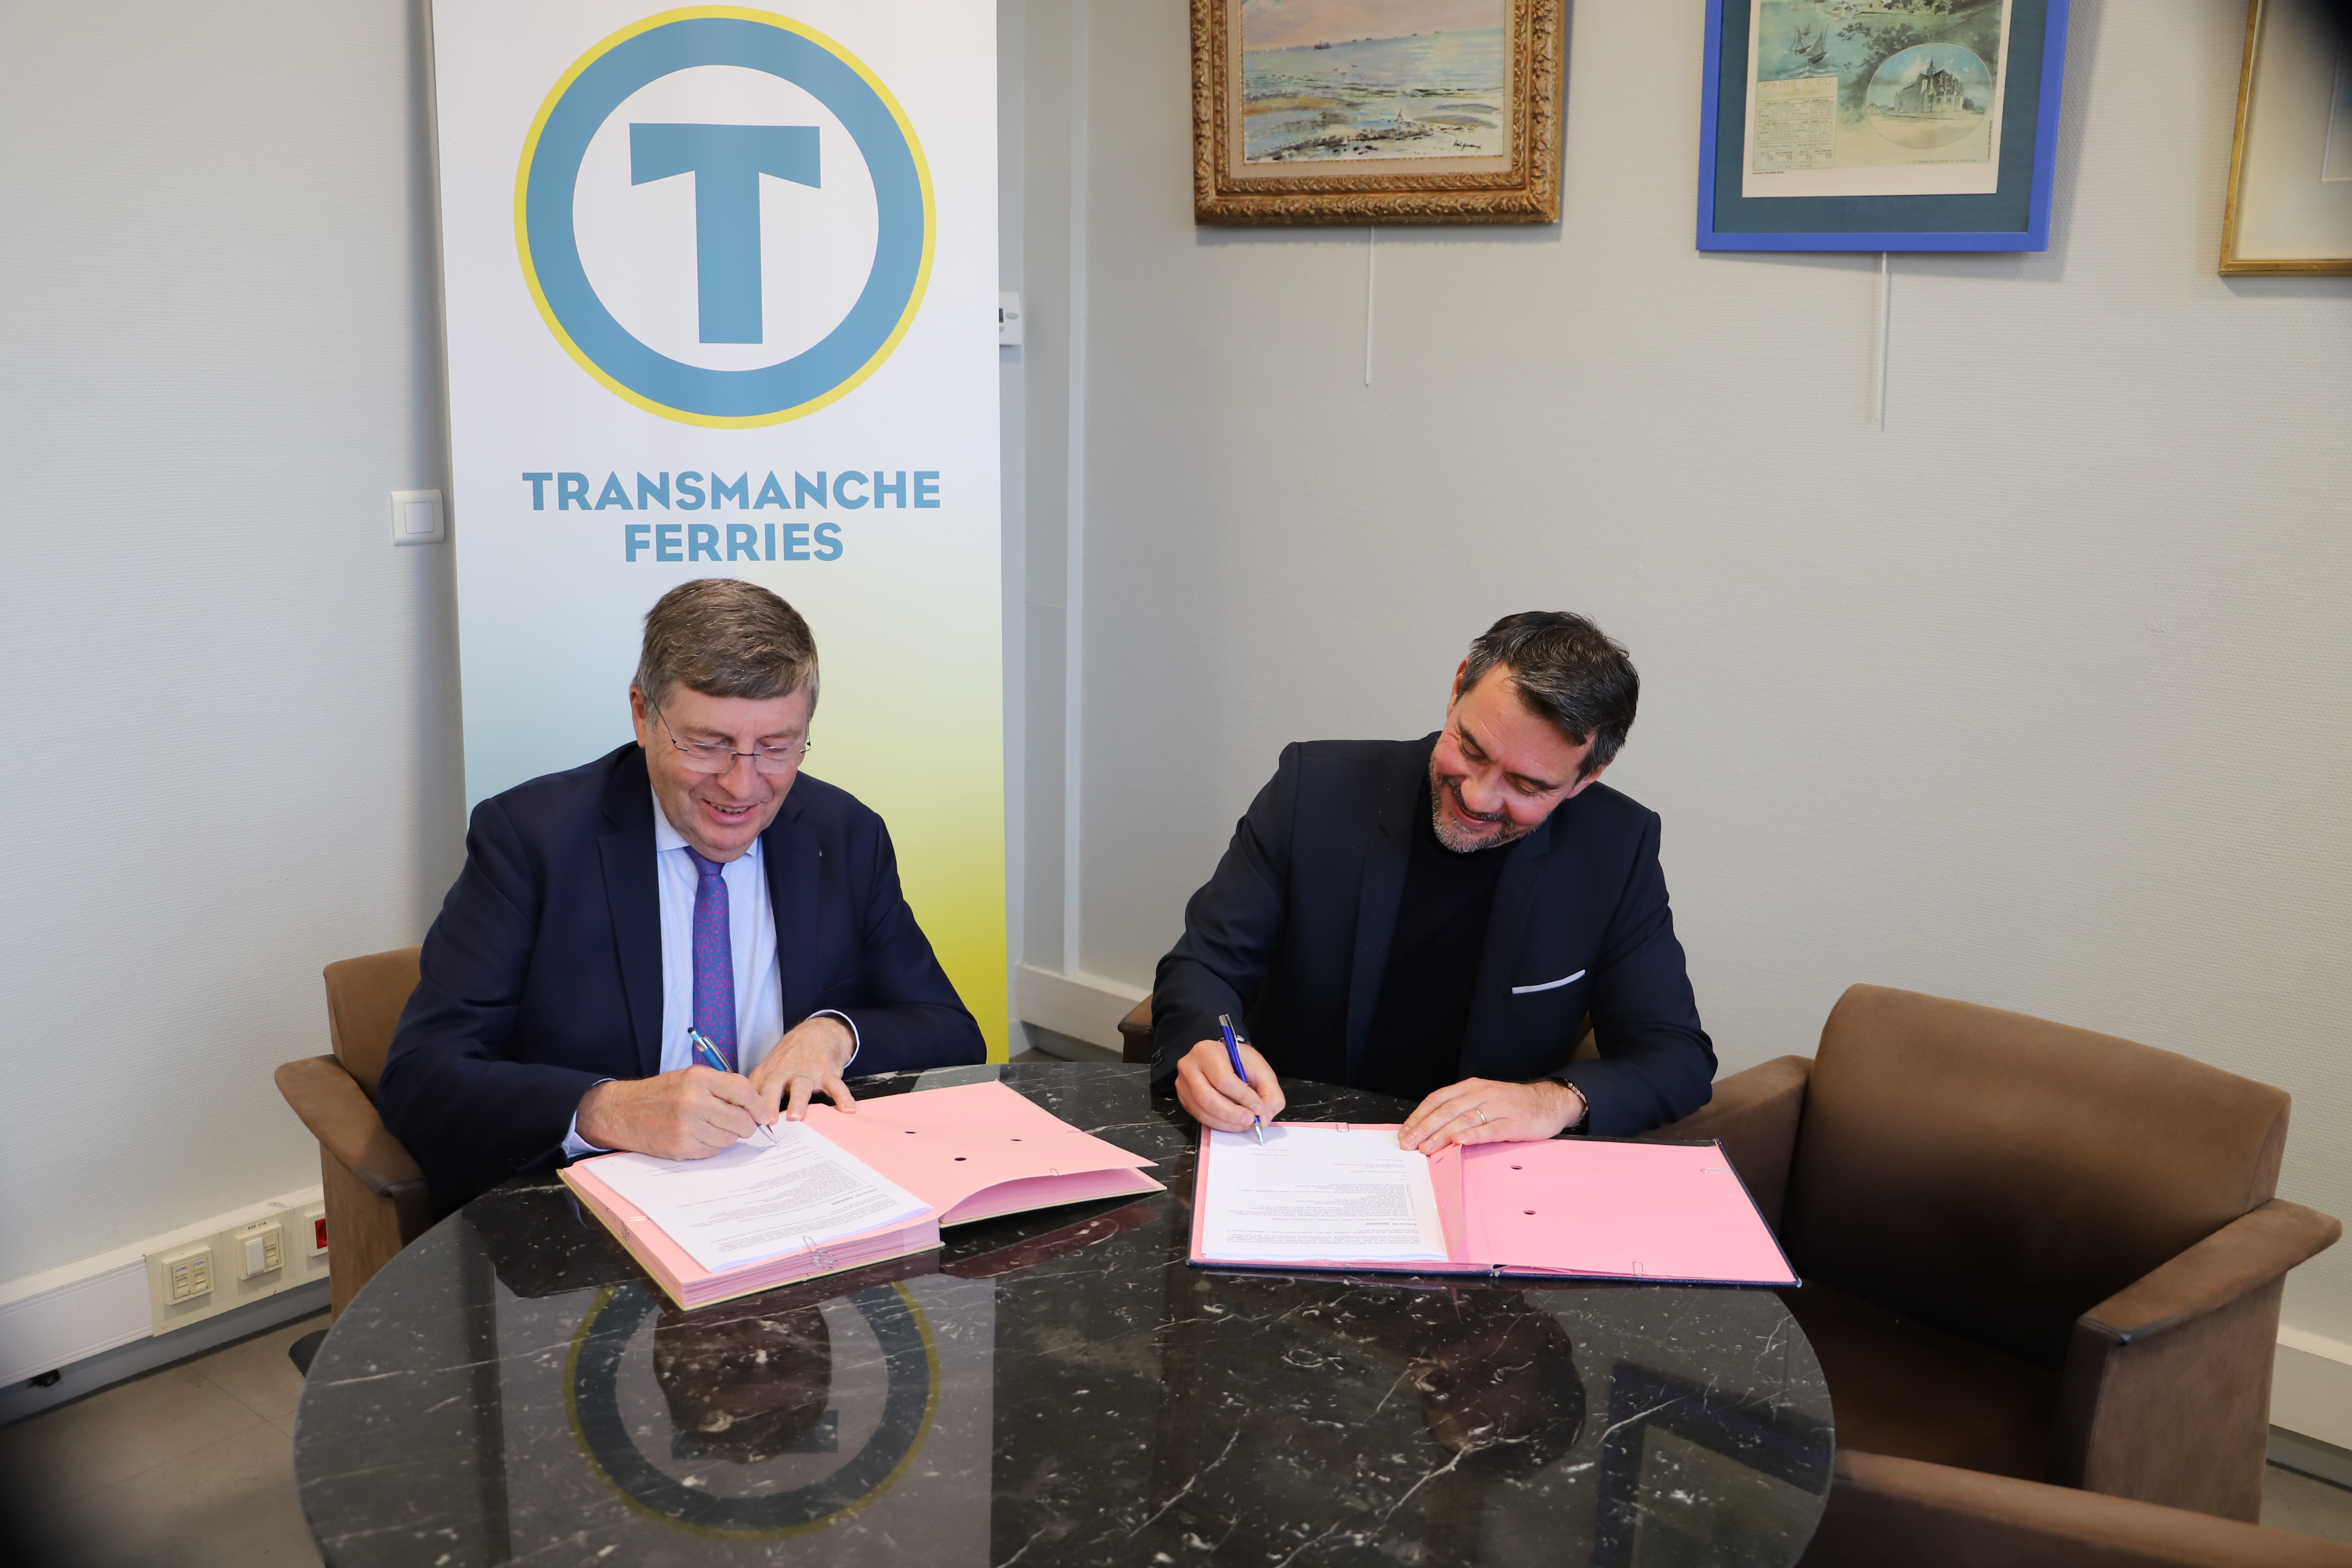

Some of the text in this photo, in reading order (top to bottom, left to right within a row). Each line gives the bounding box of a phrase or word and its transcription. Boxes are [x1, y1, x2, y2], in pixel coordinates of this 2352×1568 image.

[1763, 80, 1797, 89] PARIS
[629, 122, 821, 344] T
[522, 470, 941, 511] TRANSMANCHE
[625, 522, 843, 562] FERRIES
